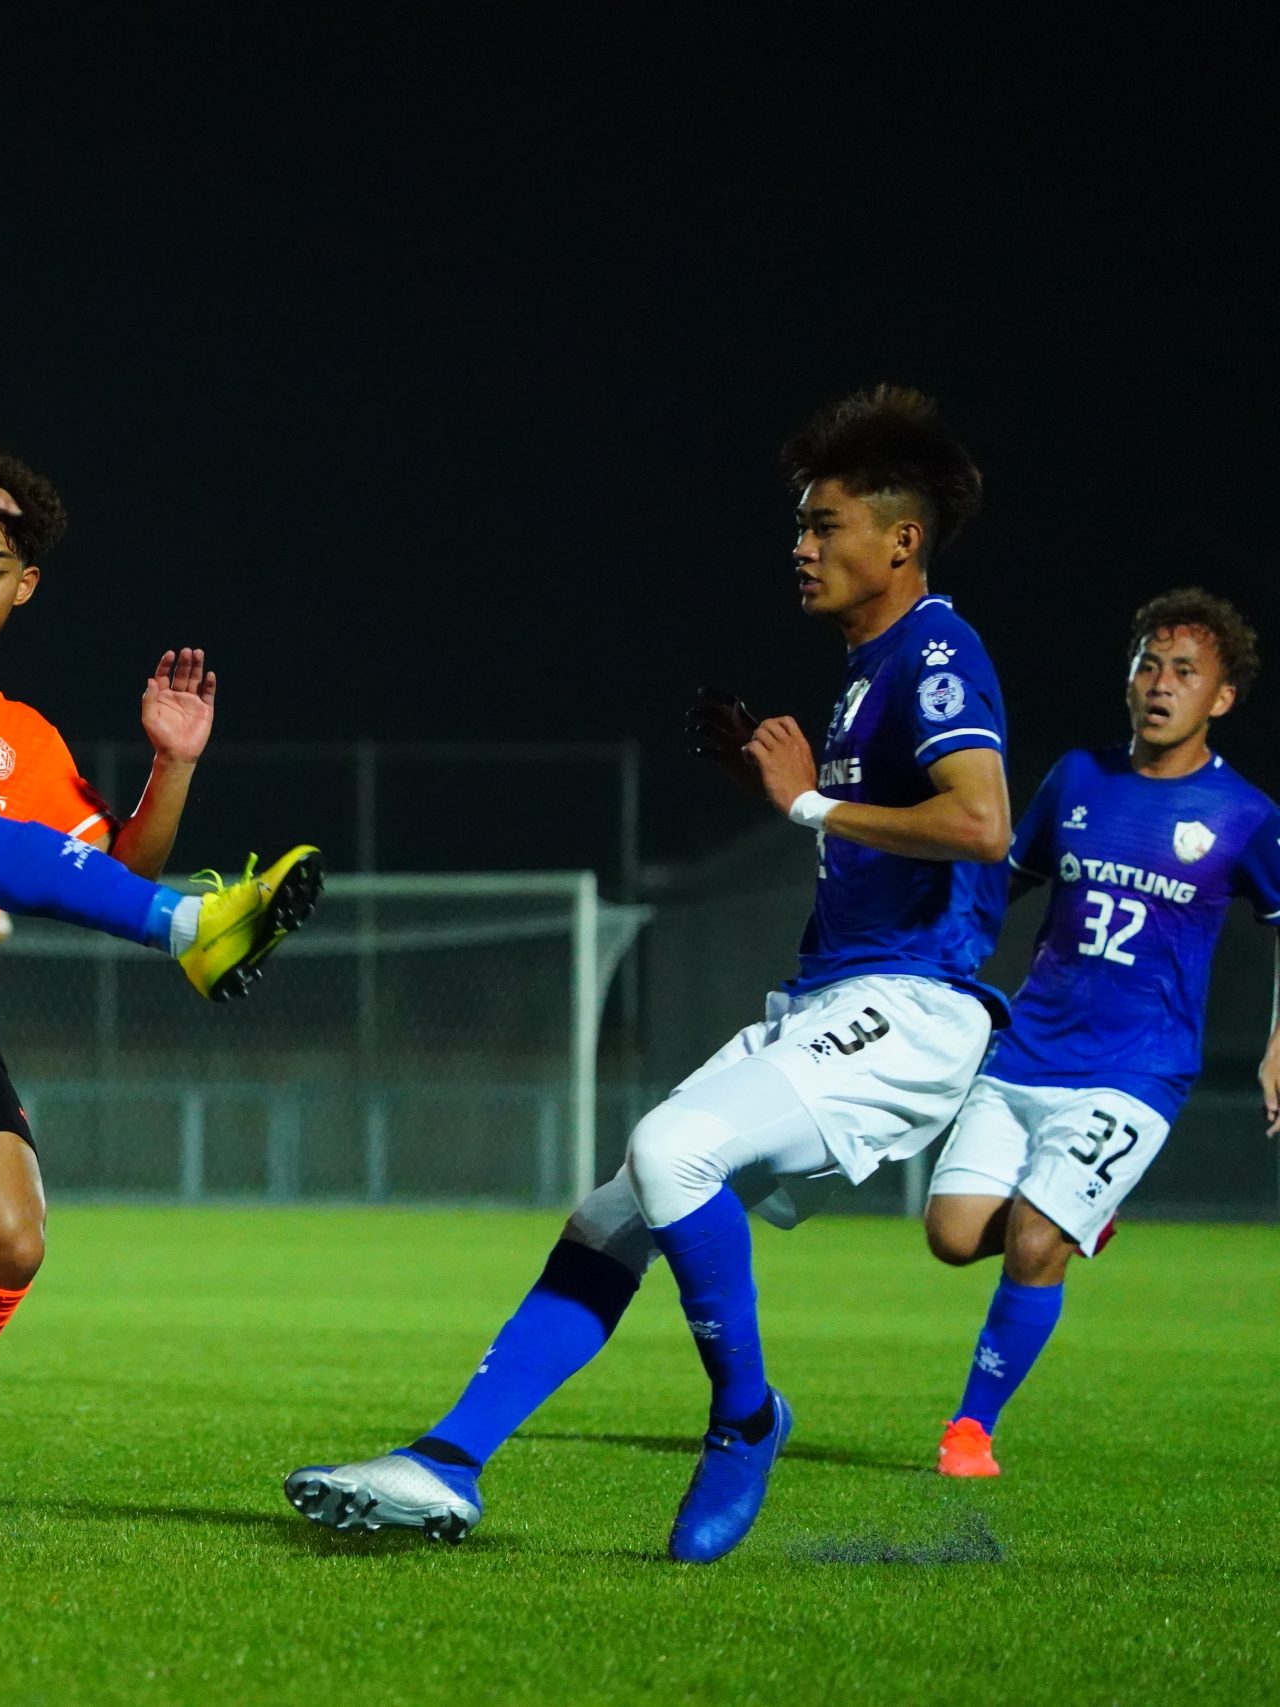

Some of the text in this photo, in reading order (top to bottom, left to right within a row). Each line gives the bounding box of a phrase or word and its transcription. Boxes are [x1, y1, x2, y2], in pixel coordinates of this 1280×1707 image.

[1082, 858, 1198, 904] TATUNG
[1078, 889, 1148, 967] 32
[822, 1006, 890, 1056] 3
[1068, 1109, 1139, 1186] 32
